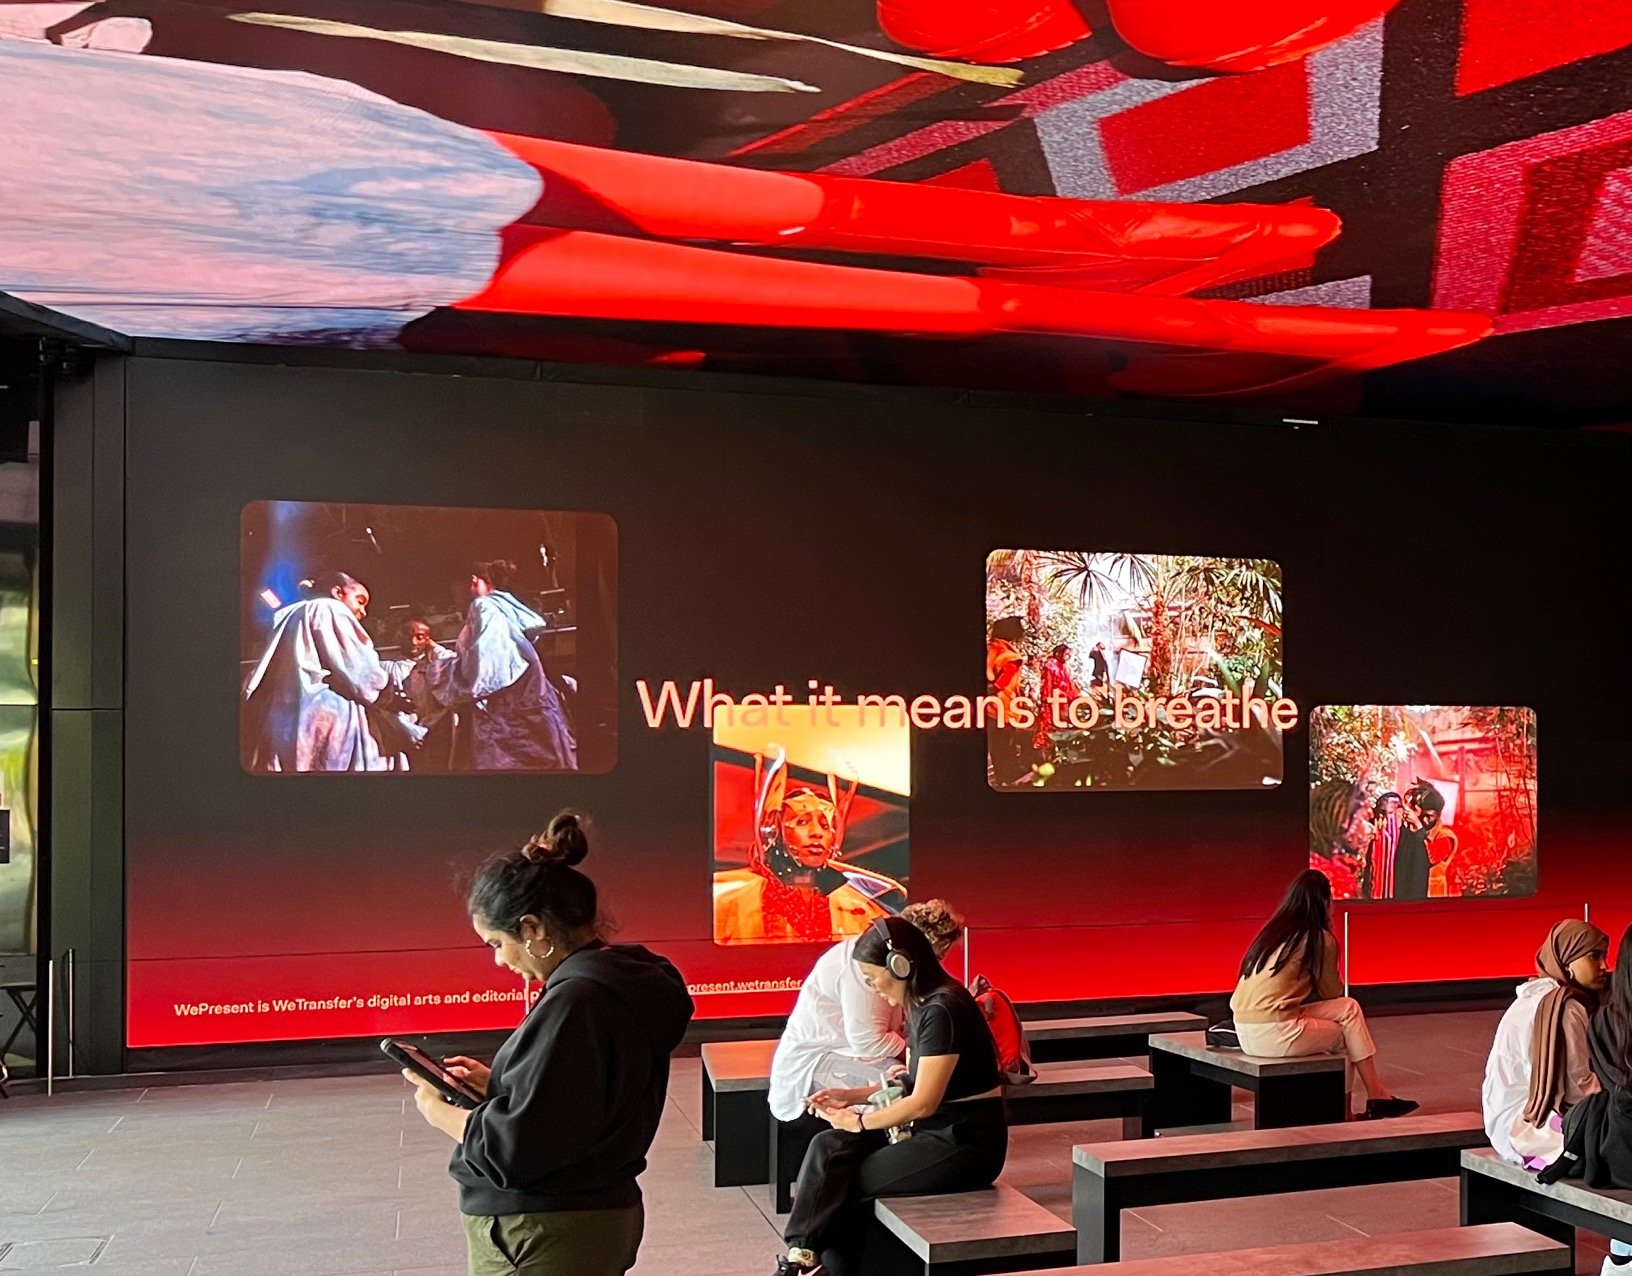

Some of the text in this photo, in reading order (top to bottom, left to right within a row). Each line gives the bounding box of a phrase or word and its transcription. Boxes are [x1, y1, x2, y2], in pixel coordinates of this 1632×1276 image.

[636, 679, 1299, 731] What it means to breathe
[174, 1002, 254, 1017] WePresent
[257, 1000, 270, 1013] is
[367, 993, 411, 1010] digital
[414, 993, 442, 1006] arts
[444, 991, 469, 1004] and
[472, 988, 528, 1003] editorial
